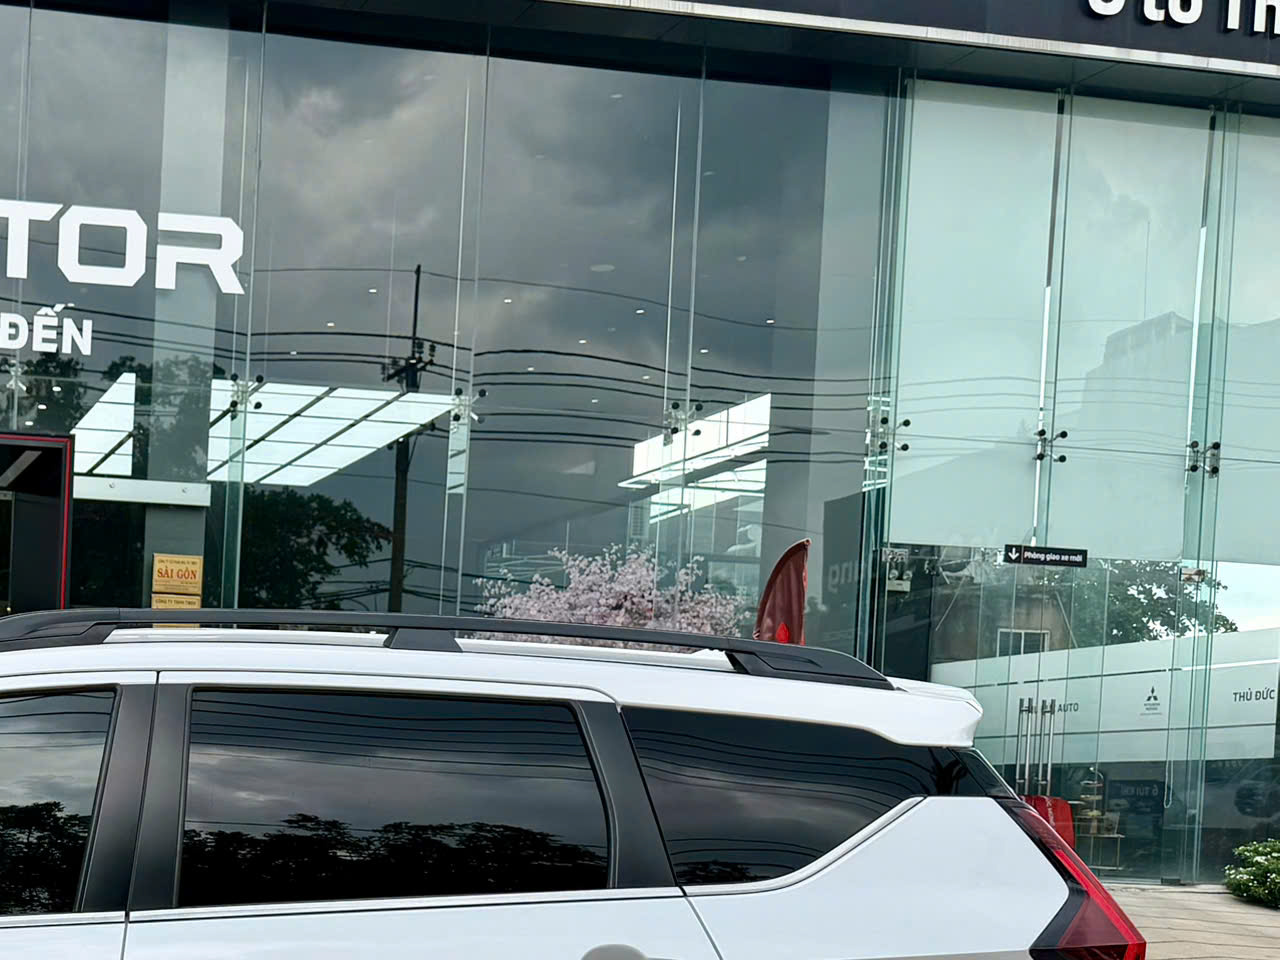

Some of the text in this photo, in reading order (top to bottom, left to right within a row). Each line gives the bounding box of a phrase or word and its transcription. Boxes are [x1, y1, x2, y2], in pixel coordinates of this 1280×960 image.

[1232, 686, 1276, 702] THỦ ĐỨC
[1057, 702, 1080, 713] AUTO
